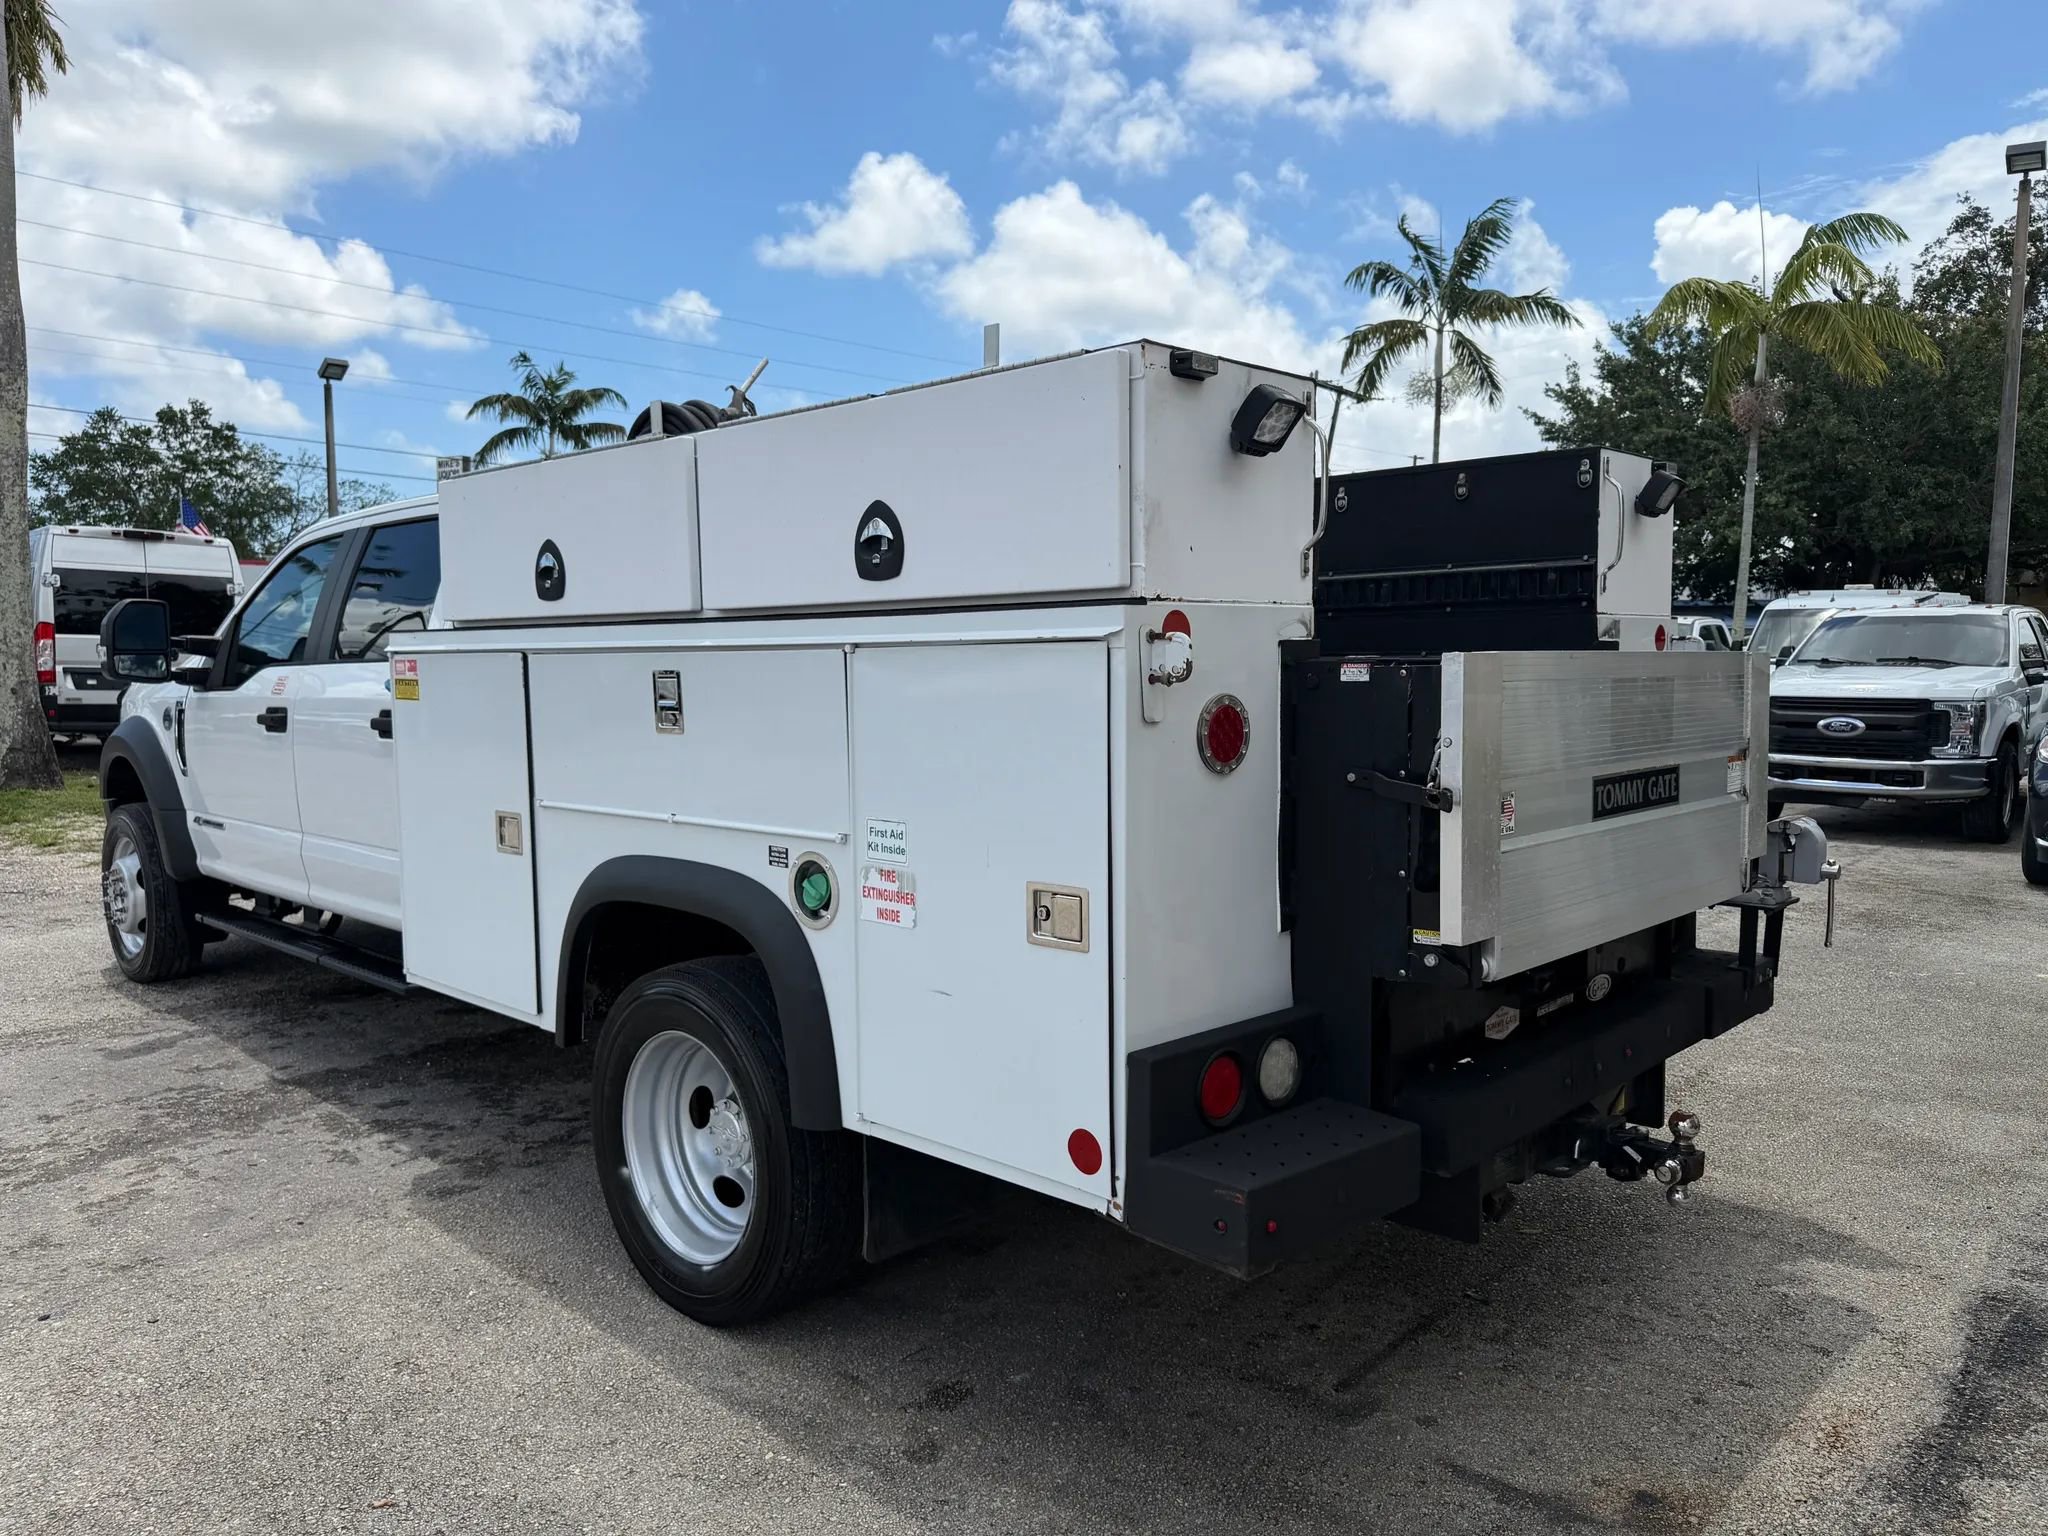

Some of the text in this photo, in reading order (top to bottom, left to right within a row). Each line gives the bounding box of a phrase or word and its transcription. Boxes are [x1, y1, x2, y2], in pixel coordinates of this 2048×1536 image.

[438, 459, 460, 469] MIKE'S
[1829, 721, 1852, 731] Ford
[1595, 773, 1678, 812] TOMMY GATE
[869, 826, 904, 840] First Aid
[868, 841, 906, 856] Kit Inside
[880, 868, 896, 883] FIRE
[862, 885, 916, 907] EXTINGUISHER
[876, 906, 901, 923] INSIDE
